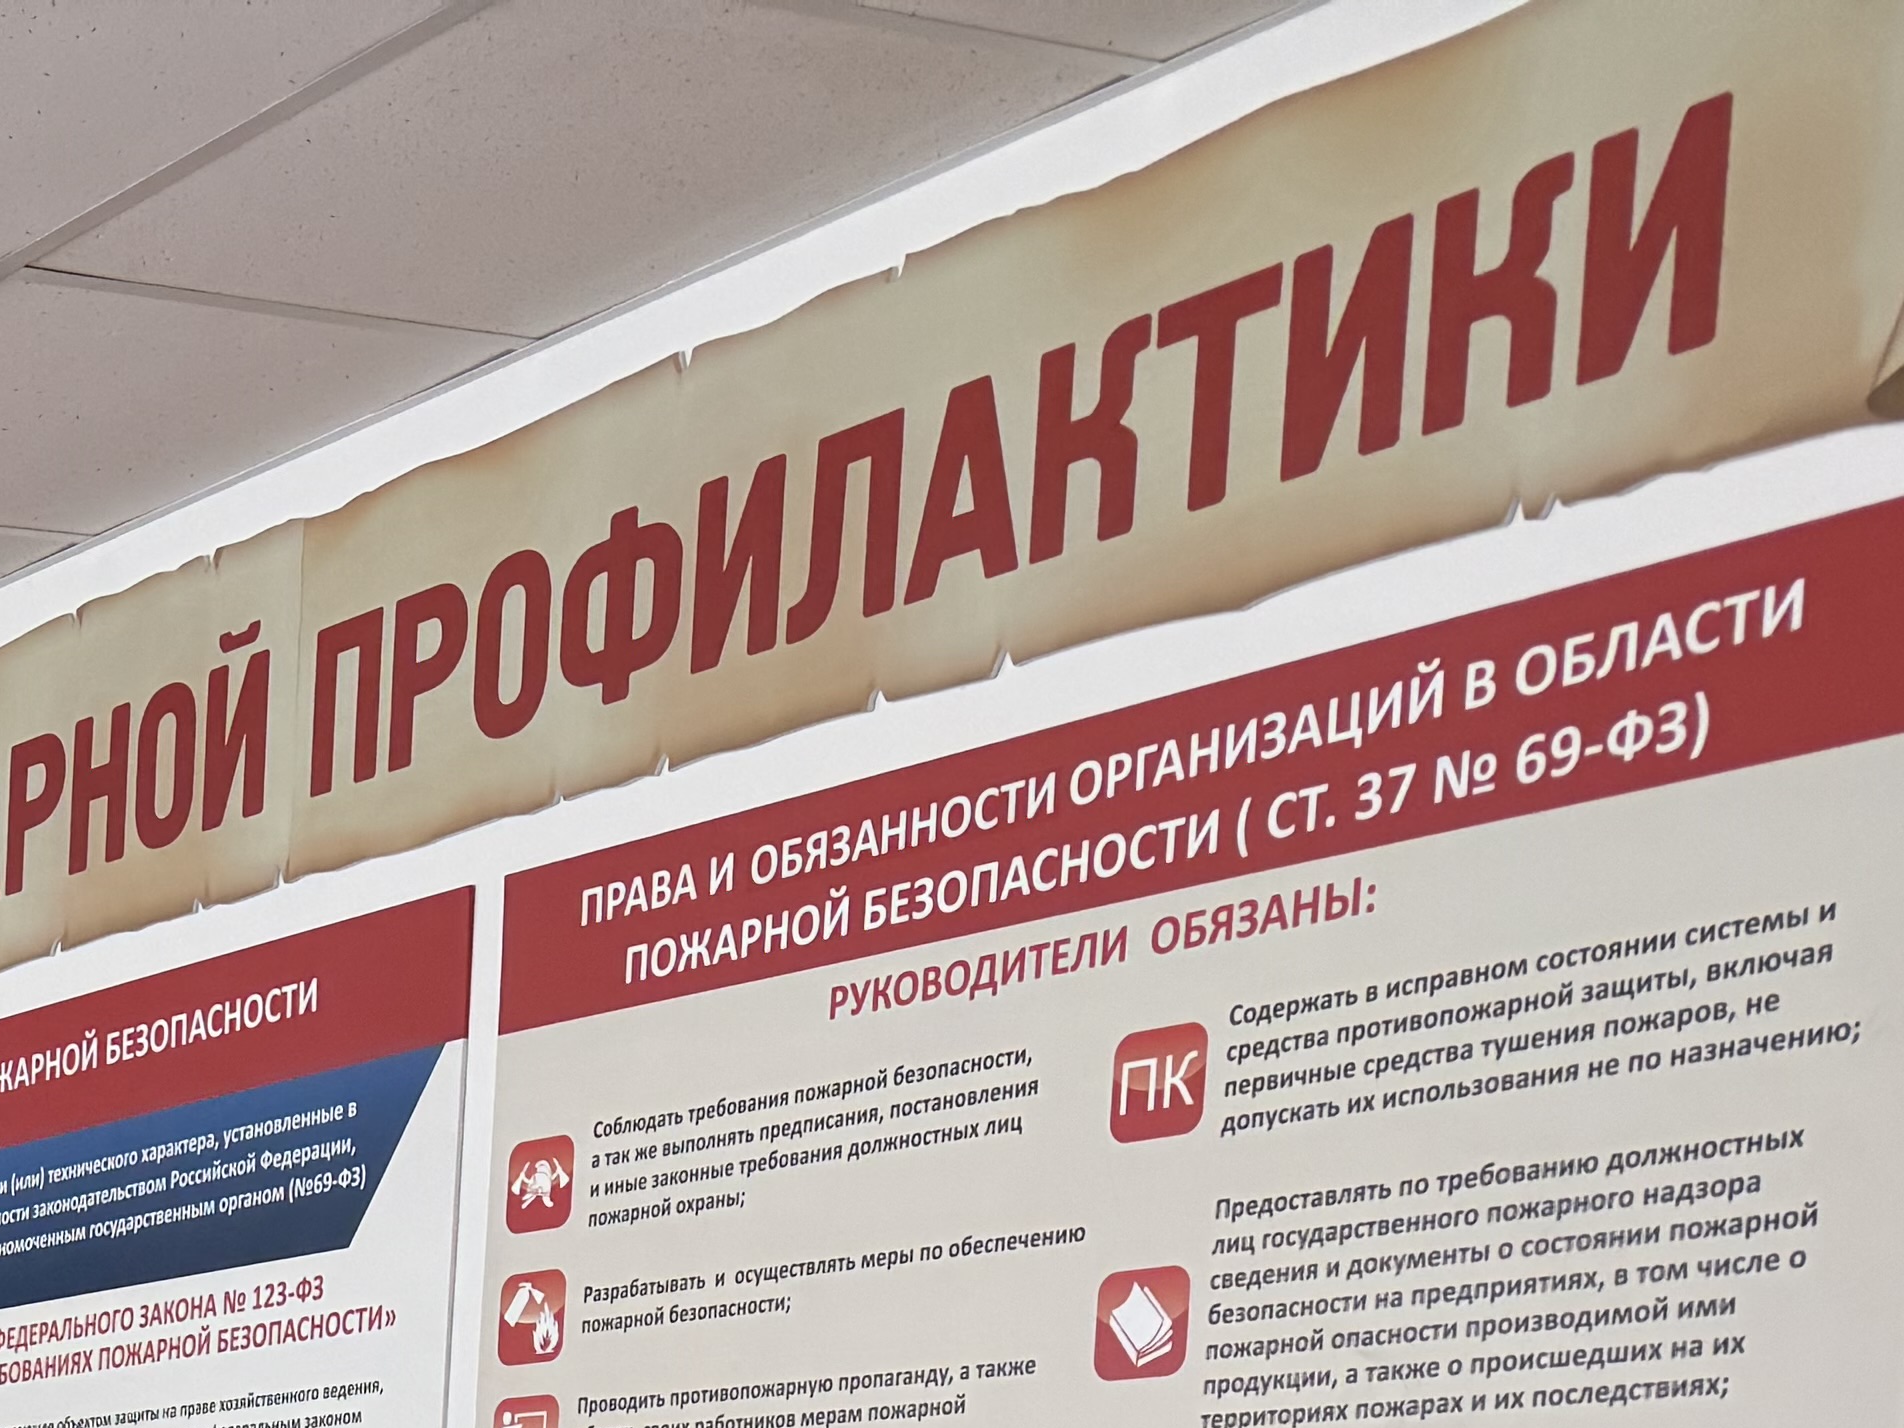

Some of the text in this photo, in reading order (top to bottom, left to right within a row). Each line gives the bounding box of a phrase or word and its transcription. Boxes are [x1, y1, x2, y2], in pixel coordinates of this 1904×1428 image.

[311, 93, 1732, 797] ПРОФИЛАКТИКИ
[581, 578, 1805, 927] ПРАВА И ОБЯЗАННОСТИ ОРГАНИЗАЦИЙ В ОБЛАСТИ
[626, 885, 850, 984] ПОЖАРНОЙ
[864, 809, 1220, 931] БЕЗОПАСНОСТИ
[1268, 784, 1335, 839] СТ.
[1355, 763, 1417, 821] 37
[1434, 750, 1497, 804] №
[1517, 692, 1709, 785] 69-ФЗ)
[830, 877, 1376, 1021] РУКОВОДИТЕЛИ ОБЯЗАНЫ:
[1230, 902, 1837, 1027] Содержать в исправном состоянии системы и
[107, 978, 318, 1065] БЕЗОПАСНОСТИ
[1225, 994, 1780, 1099] первичные средства тушения пожаров, не
[1227, 944, 1833, 1066] средства противопожарной защиты, включая
[592, 1080, 1039, 1169] а так же выполнять предписания, постановления
[594, 1049, 1032, 1139] Соблюдать требования пожарной безопасности,
[1119, 1051, 1198, 1117] ПК
[1221, 1021, 1861, 1138] допускать их использования не по назначению;
[590, 1116, 1023, 1198] и иные законные требования должностных лиц
[589, 1192, 746, 1228] пожарной охраны;
[98, 1331, 211, 1371] ПОЖАРНОЙ
[218, 1305, 396, 1354] БЕЗОПАСНОСТИ»
[139, 1294, 217, 1329] ЗАКОНА
[224, 1290, 246, 1315] №
[253, 1275, 324, 1310] 123-ФЗ
